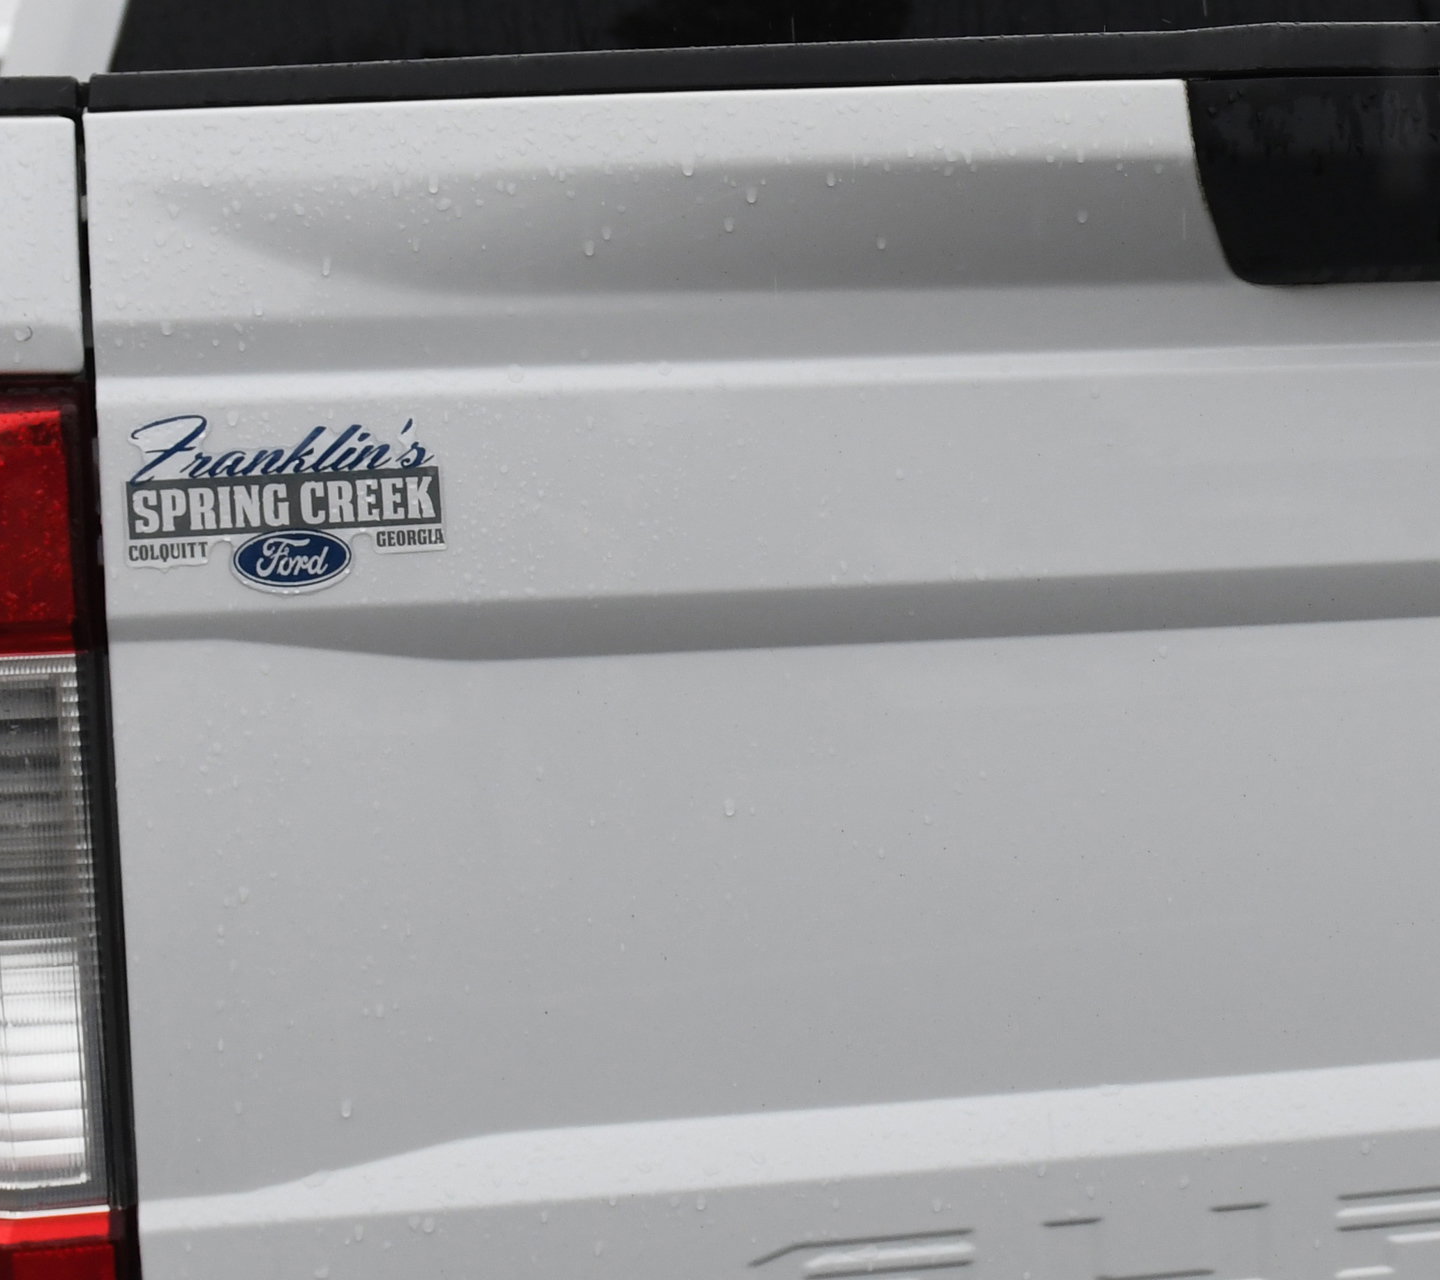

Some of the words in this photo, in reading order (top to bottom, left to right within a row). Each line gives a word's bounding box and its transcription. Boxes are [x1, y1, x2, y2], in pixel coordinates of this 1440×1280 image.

[130, 415, 434, 487] Franklin's
[132, 484, 291, 534] SPRING
[299, 475, 436, 526] CREEK
[128, 540, 209, 563] COLQUITT
[256, 537, 328, 577] Ford
[376, 527, 445, 548] GEORGIA
